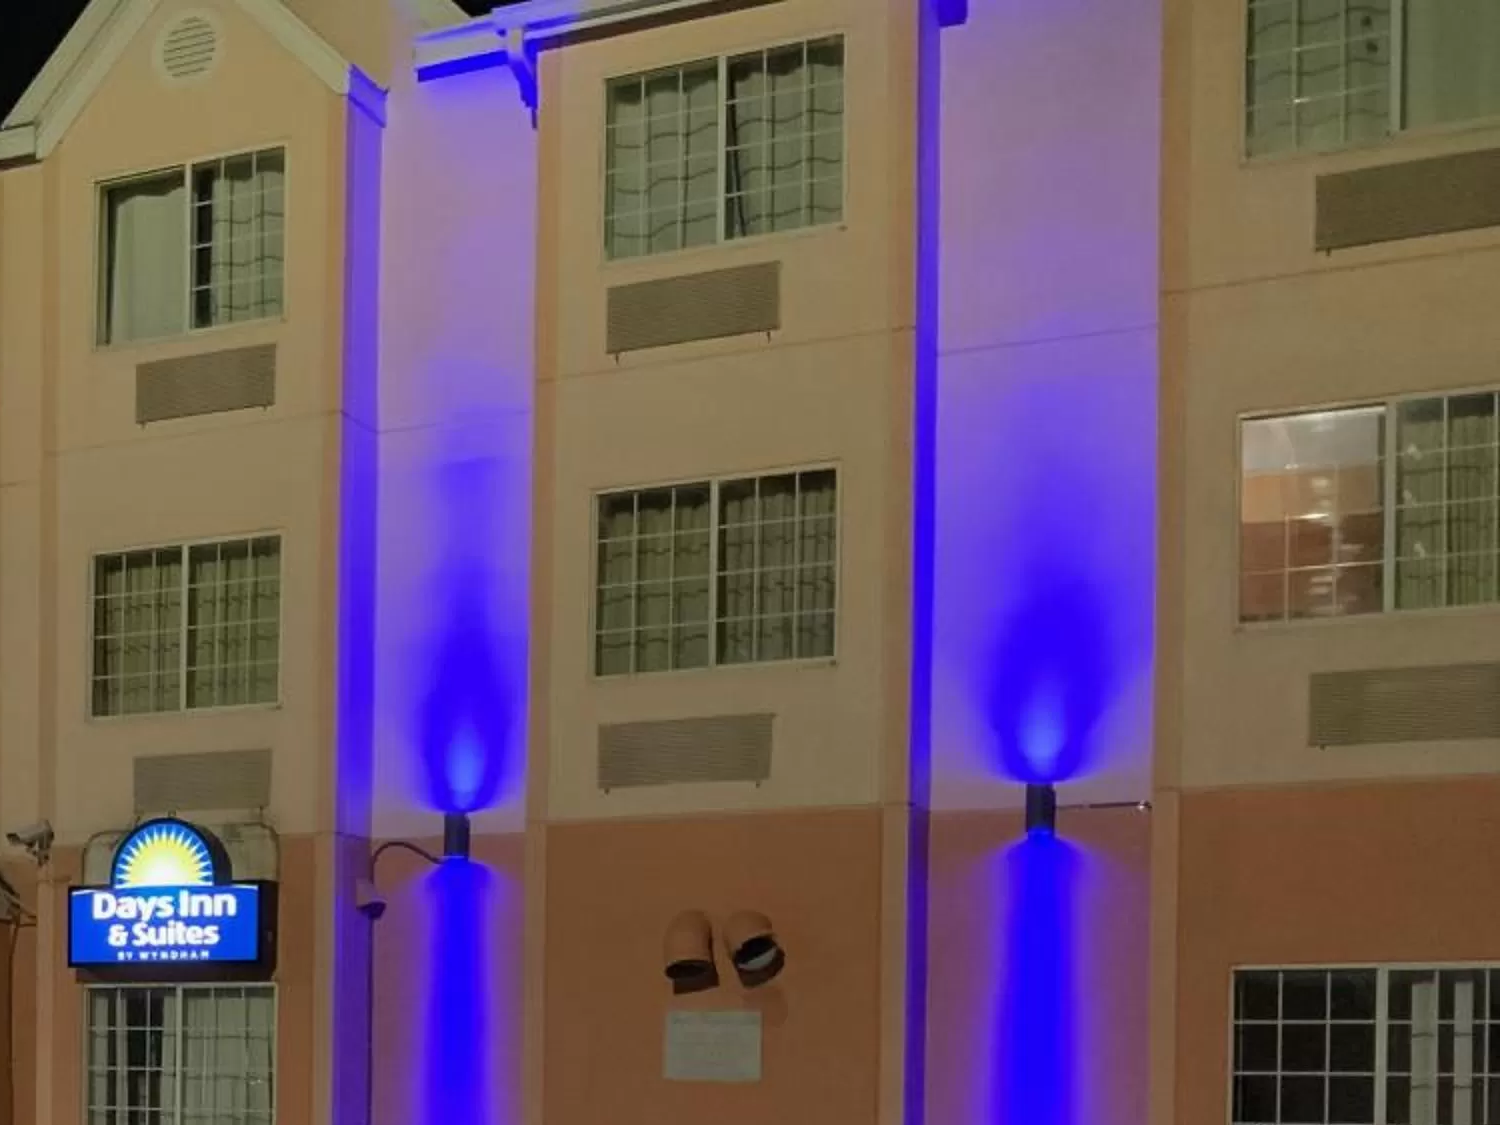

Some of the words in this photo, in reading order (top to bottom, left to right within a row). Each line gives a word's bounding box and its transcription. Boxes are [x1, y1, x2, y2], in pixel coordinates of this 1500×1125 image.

[92, 891, 175, 922] Days
[179, 890, 236, 917] Inn
[108, 923, 129, 946] &
[132, 920, 220, 946] Suites
[117, 951, 133, 961] BY
[139, 950, 210, 960] WYNDHAM
